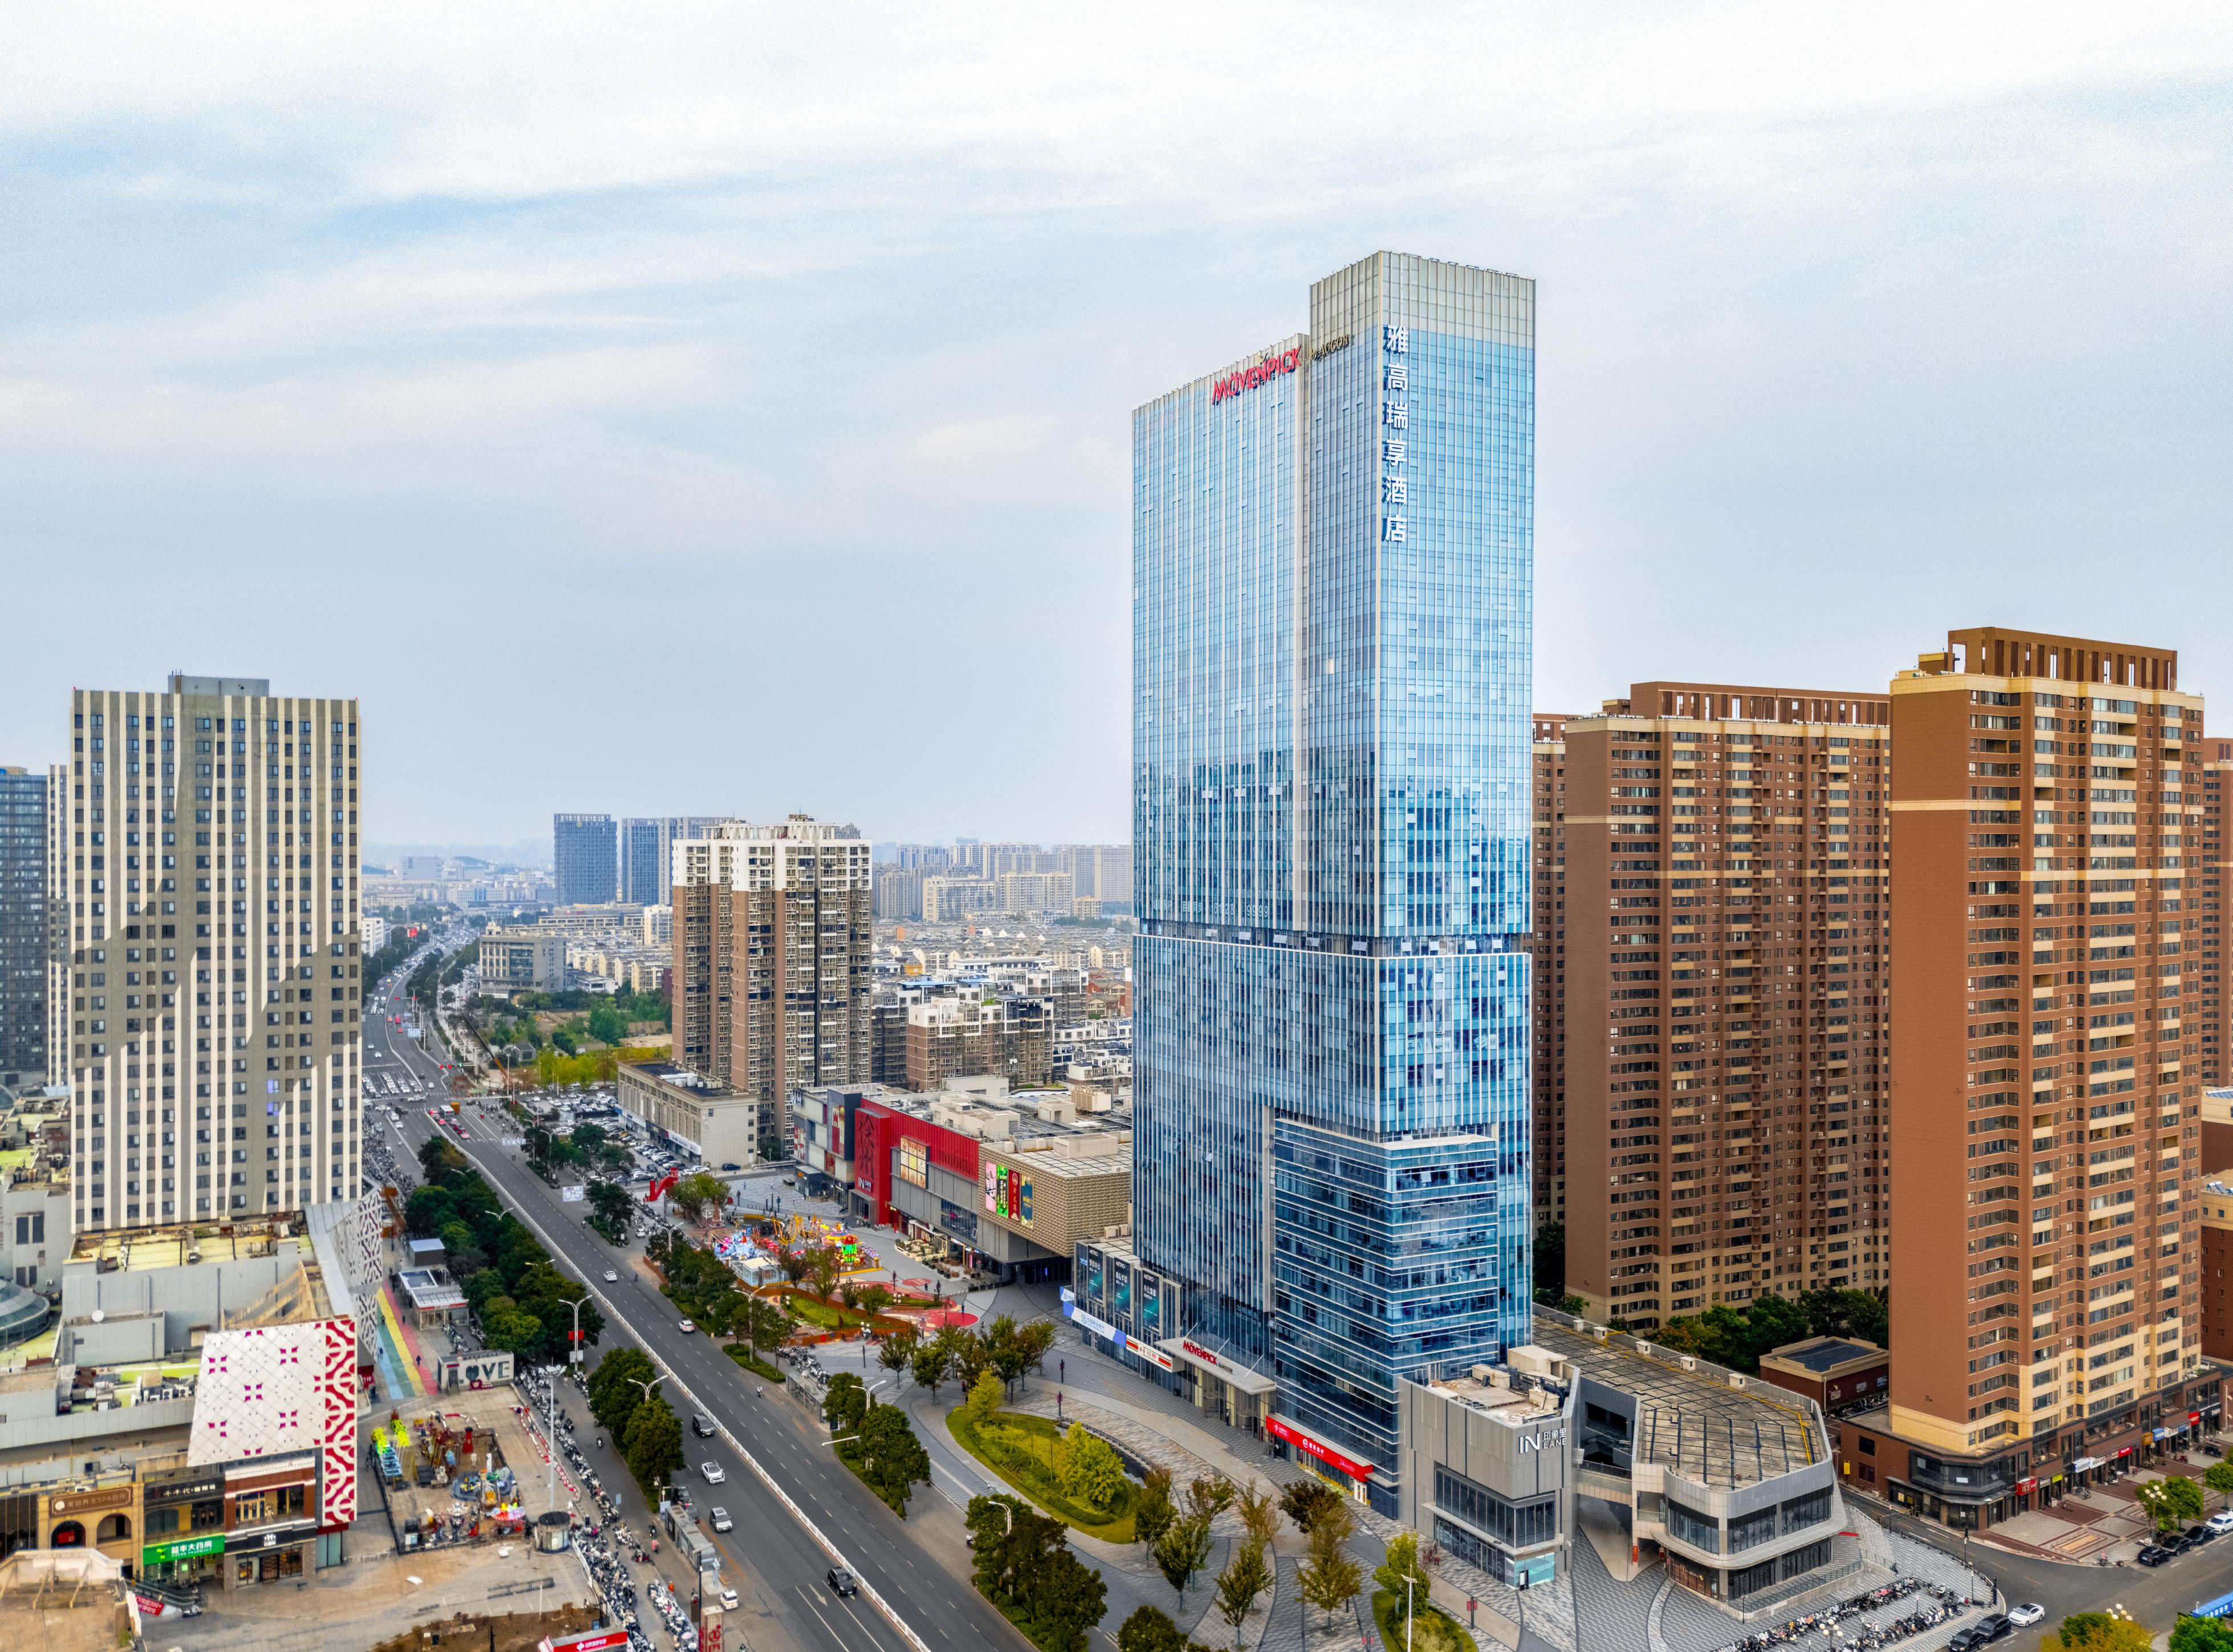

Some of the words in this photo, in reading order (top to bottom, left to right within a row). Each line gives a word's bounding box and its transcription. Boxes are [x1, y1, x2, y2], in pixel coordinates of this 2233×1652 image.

[1211, 344, 1302, 405] MÖVENPICK
[1385, 324, 1409, 543] 雅高瑞享酒店
[1183, 1340, 1217, 1365] MÖVENPICK
[1519, 1433, 1540, 1454] IN
[1543, 1428, 1566, 1441] 印象里
[1543, 1438, 1567, 1449] LANE
[171, 1540, 212, 1554] 益丰大药房
